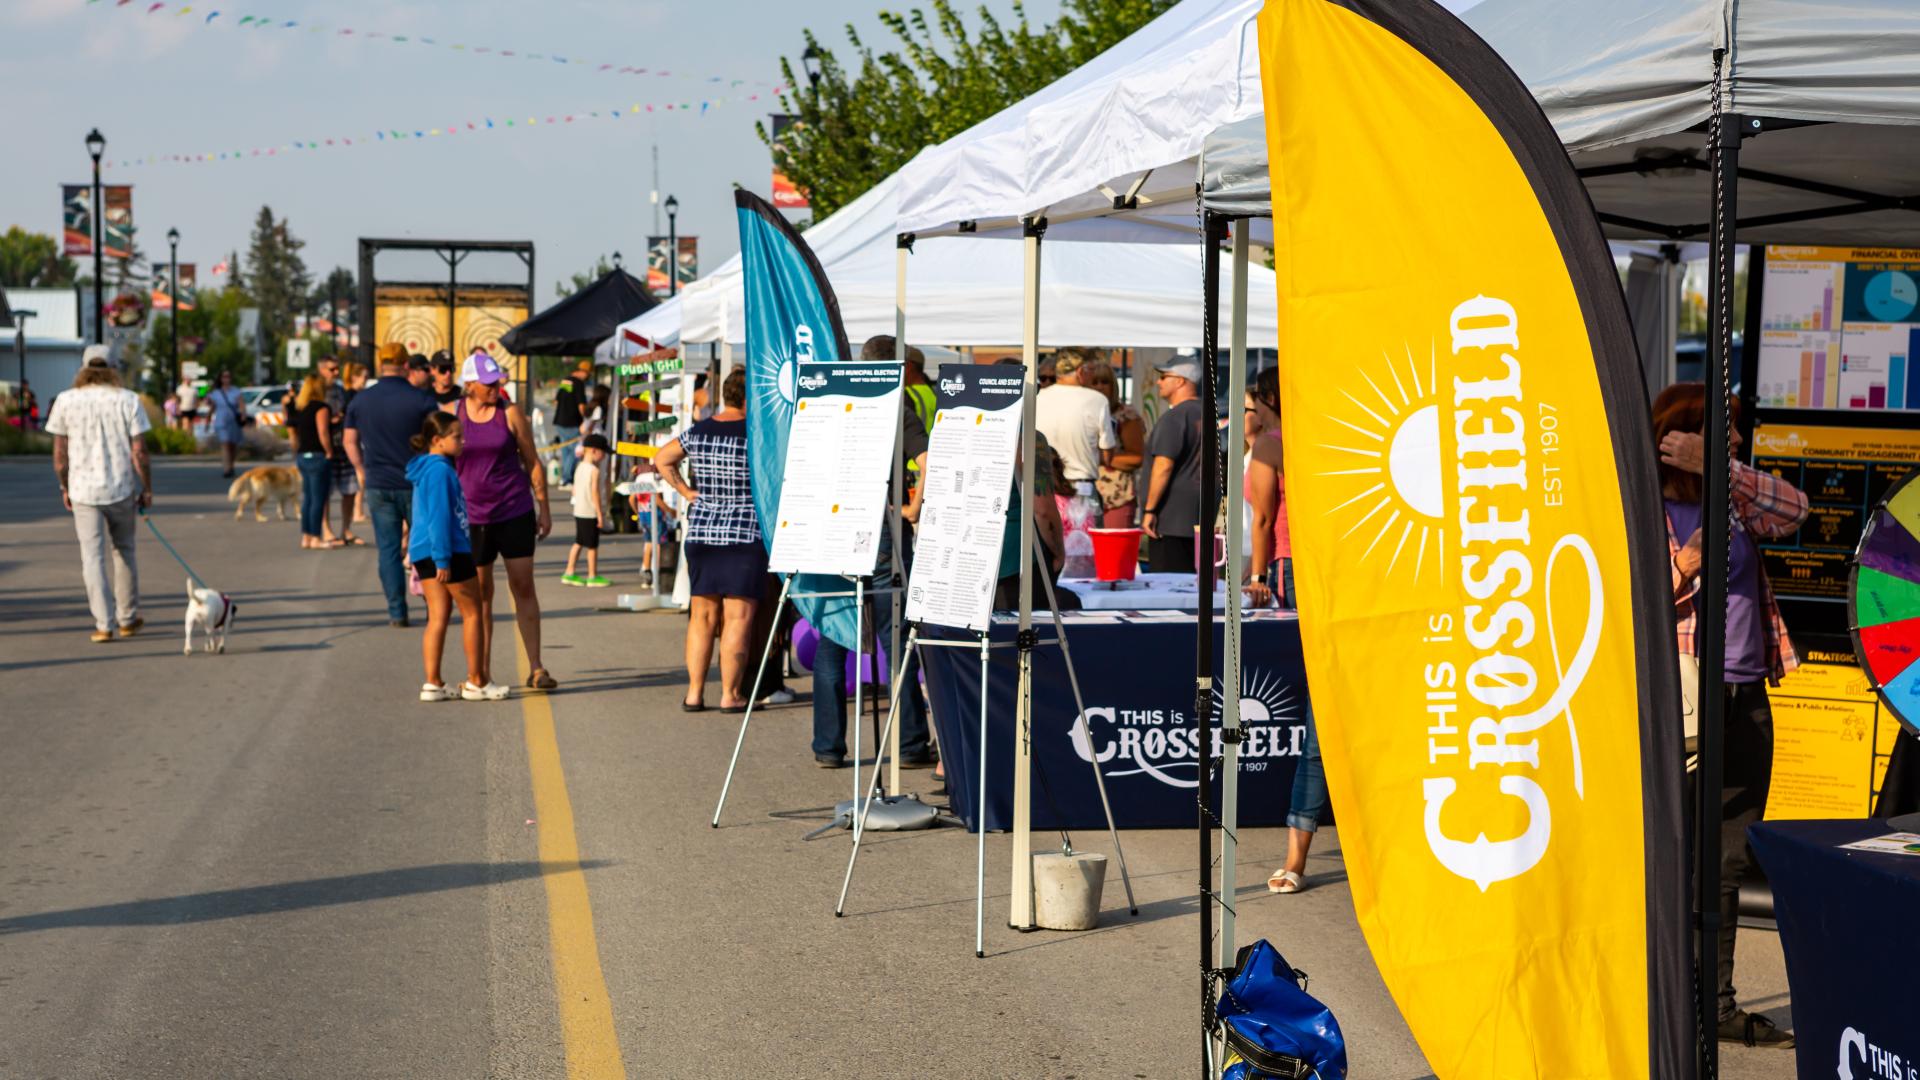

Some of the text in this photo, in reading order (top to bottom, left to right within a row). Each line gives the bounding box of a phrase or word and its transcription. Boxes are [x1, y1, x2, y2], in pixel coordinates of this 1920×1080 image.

[874, 368, 899, 376] ELECTION
[979, 378, 997, 386] COUNCIL
[1007, 379, 1022, 387] STAFF
[1539, 402, 1563, 507] EST 1907
[1802, 448, 1856, 457] COMMUNITY
[1807, 651, 1856, 663] STRATEGIC
[1423, 613, 1458, 765] THIS is
[1120, 709, 1184, 725] THIS is
[1245, 762, 1268, 772] 1907
[1868, 1043, 1903, 1080] THIS
